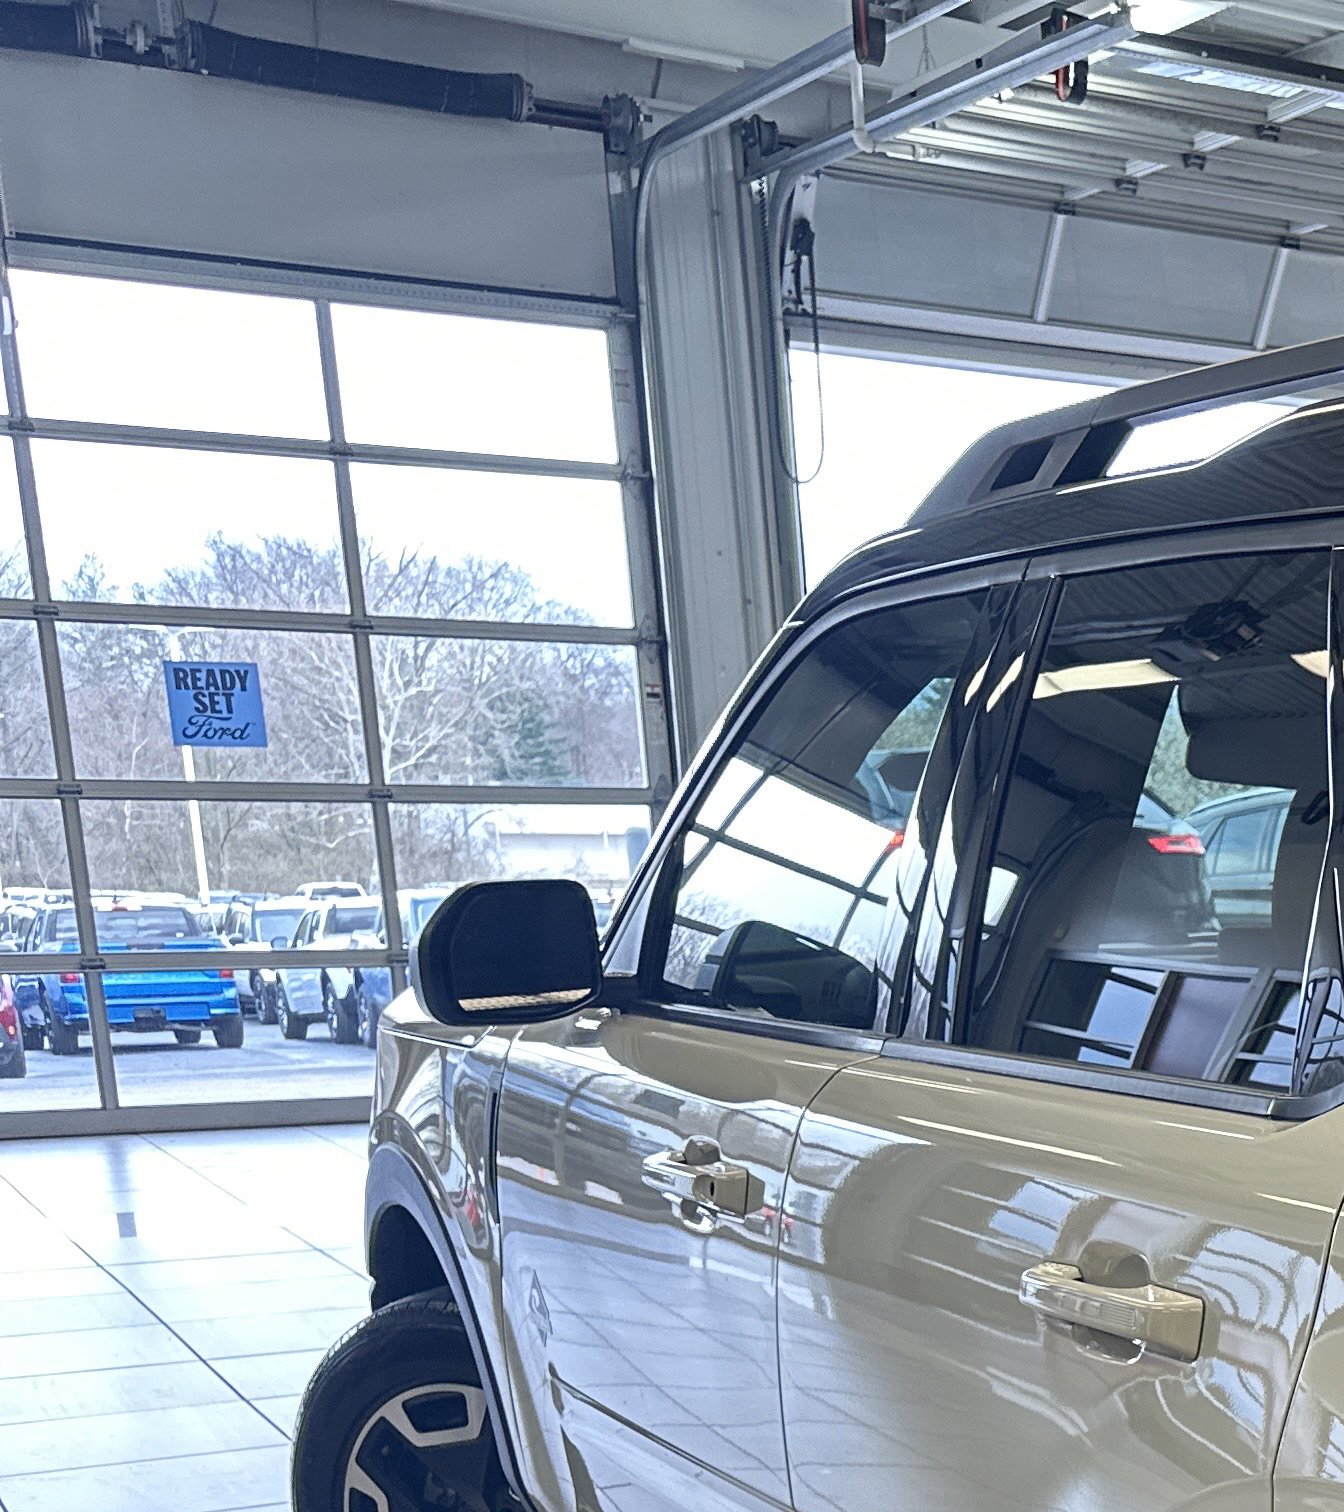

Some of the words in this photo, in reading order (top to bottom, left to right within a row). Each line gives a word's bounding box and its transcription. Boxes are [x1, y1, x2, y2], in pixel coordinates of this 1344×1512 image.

[173, 667, 249, 692] READY
[193, 691, 235, 714] SET
[182, 714, 251, 740] Ford
